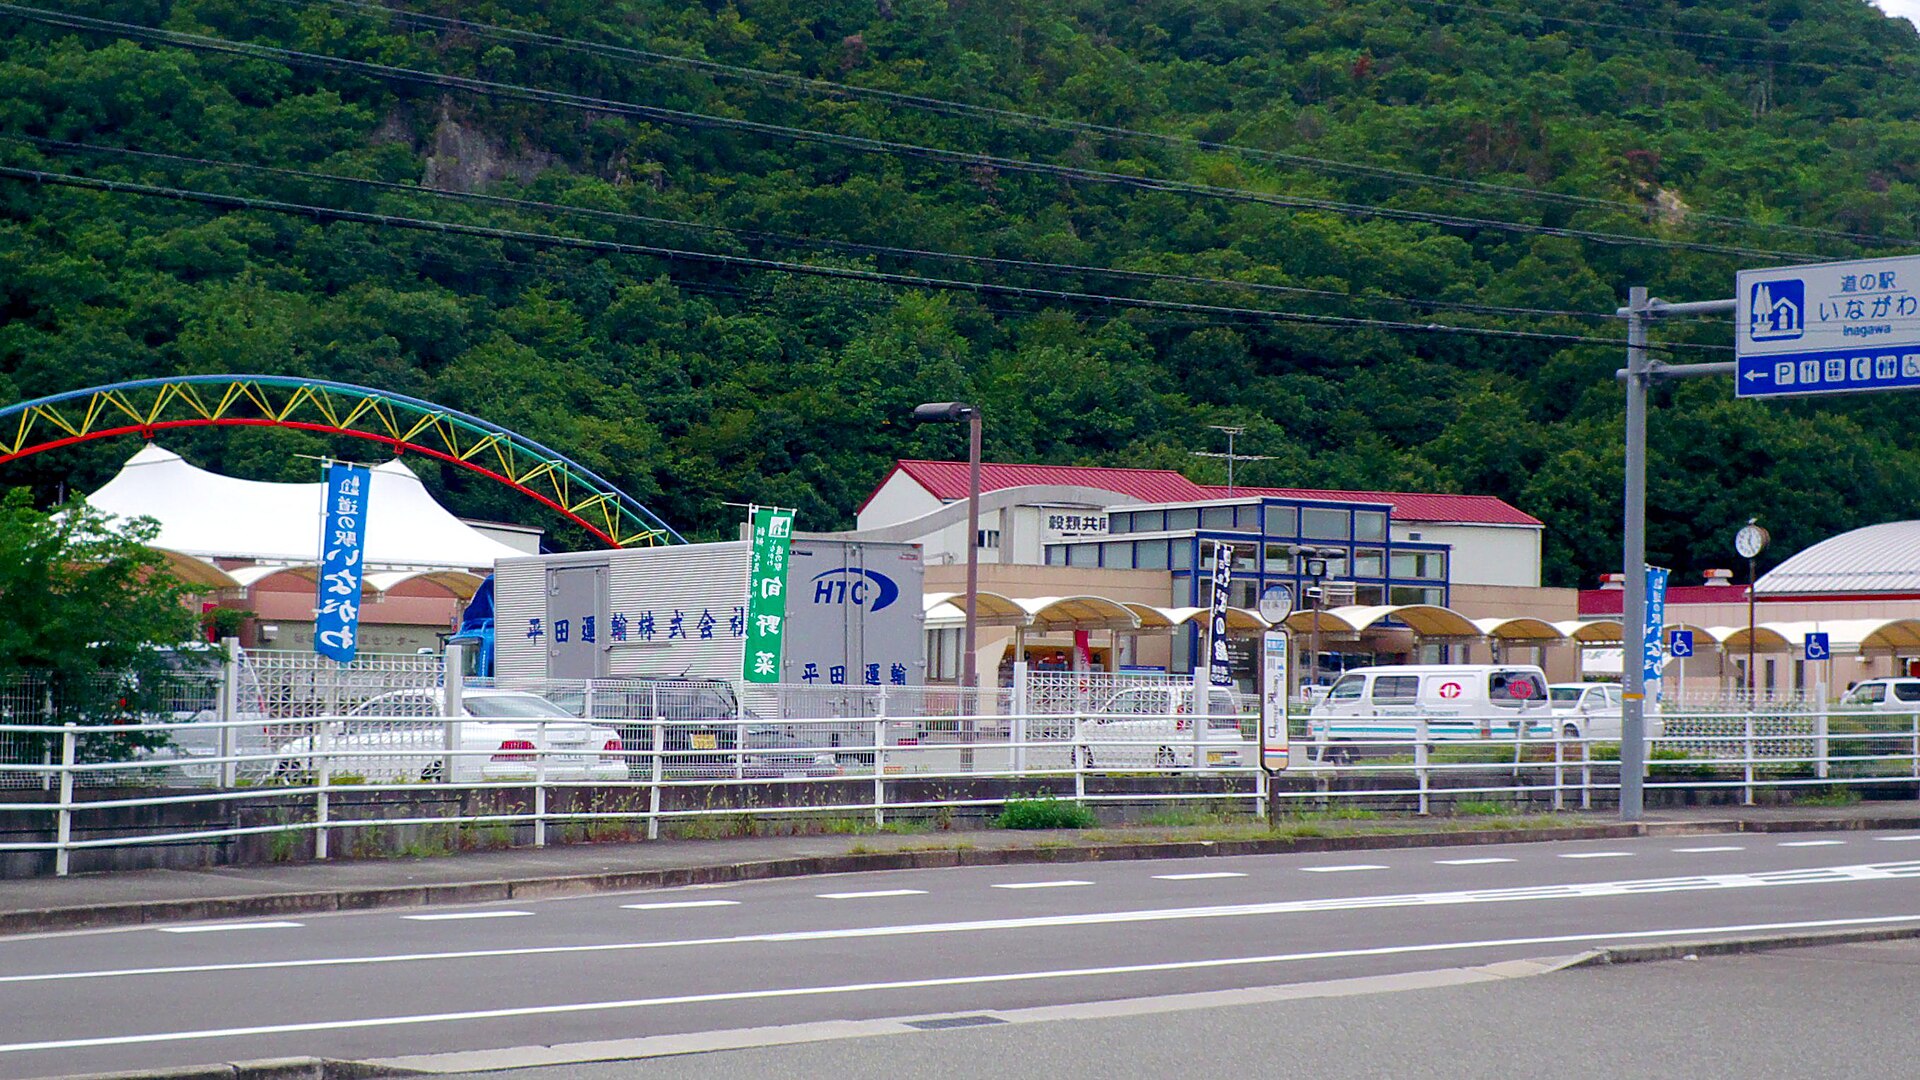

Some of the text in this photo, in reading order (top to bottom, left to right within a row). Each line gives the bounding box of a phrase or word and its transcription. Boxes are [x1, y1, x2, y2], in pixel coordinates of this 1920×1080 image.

[1841, 271, 1896, 293] 道の駅
[1819, 294, 1918, 321] いながわ
[1843, 324, 1892, 338] Inagawa
[1779, 364, 1791, 384] P
[814, 580, 868, 605] HTC
[802, 663, 907, 685] 平田運輸
